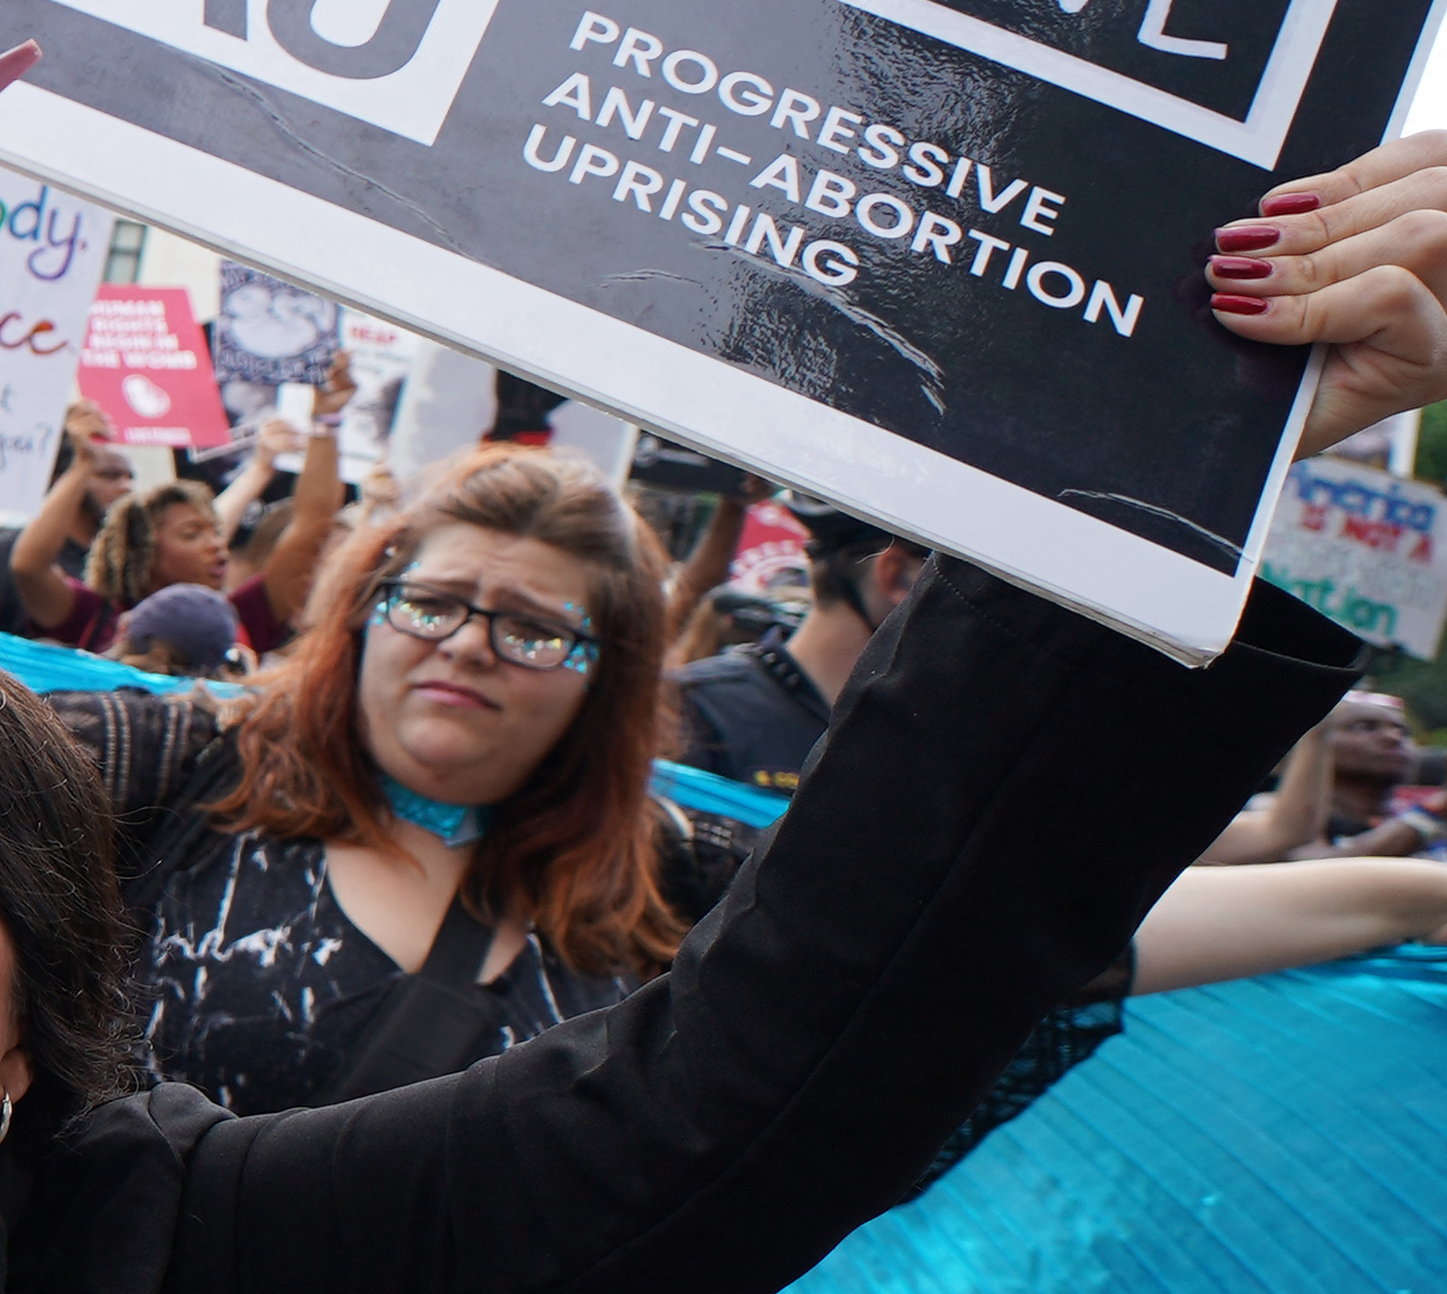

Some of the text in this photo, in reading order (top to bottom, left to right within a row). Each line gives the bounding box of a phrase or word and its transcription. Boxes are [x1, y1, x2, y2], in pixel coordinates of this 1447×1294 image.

[522, 123, 860, 289] UPRISING
[541, 73, 1144, 339] ANTI-ABORTION
[570, 9, 1066, 236] PROGRESSIVE
